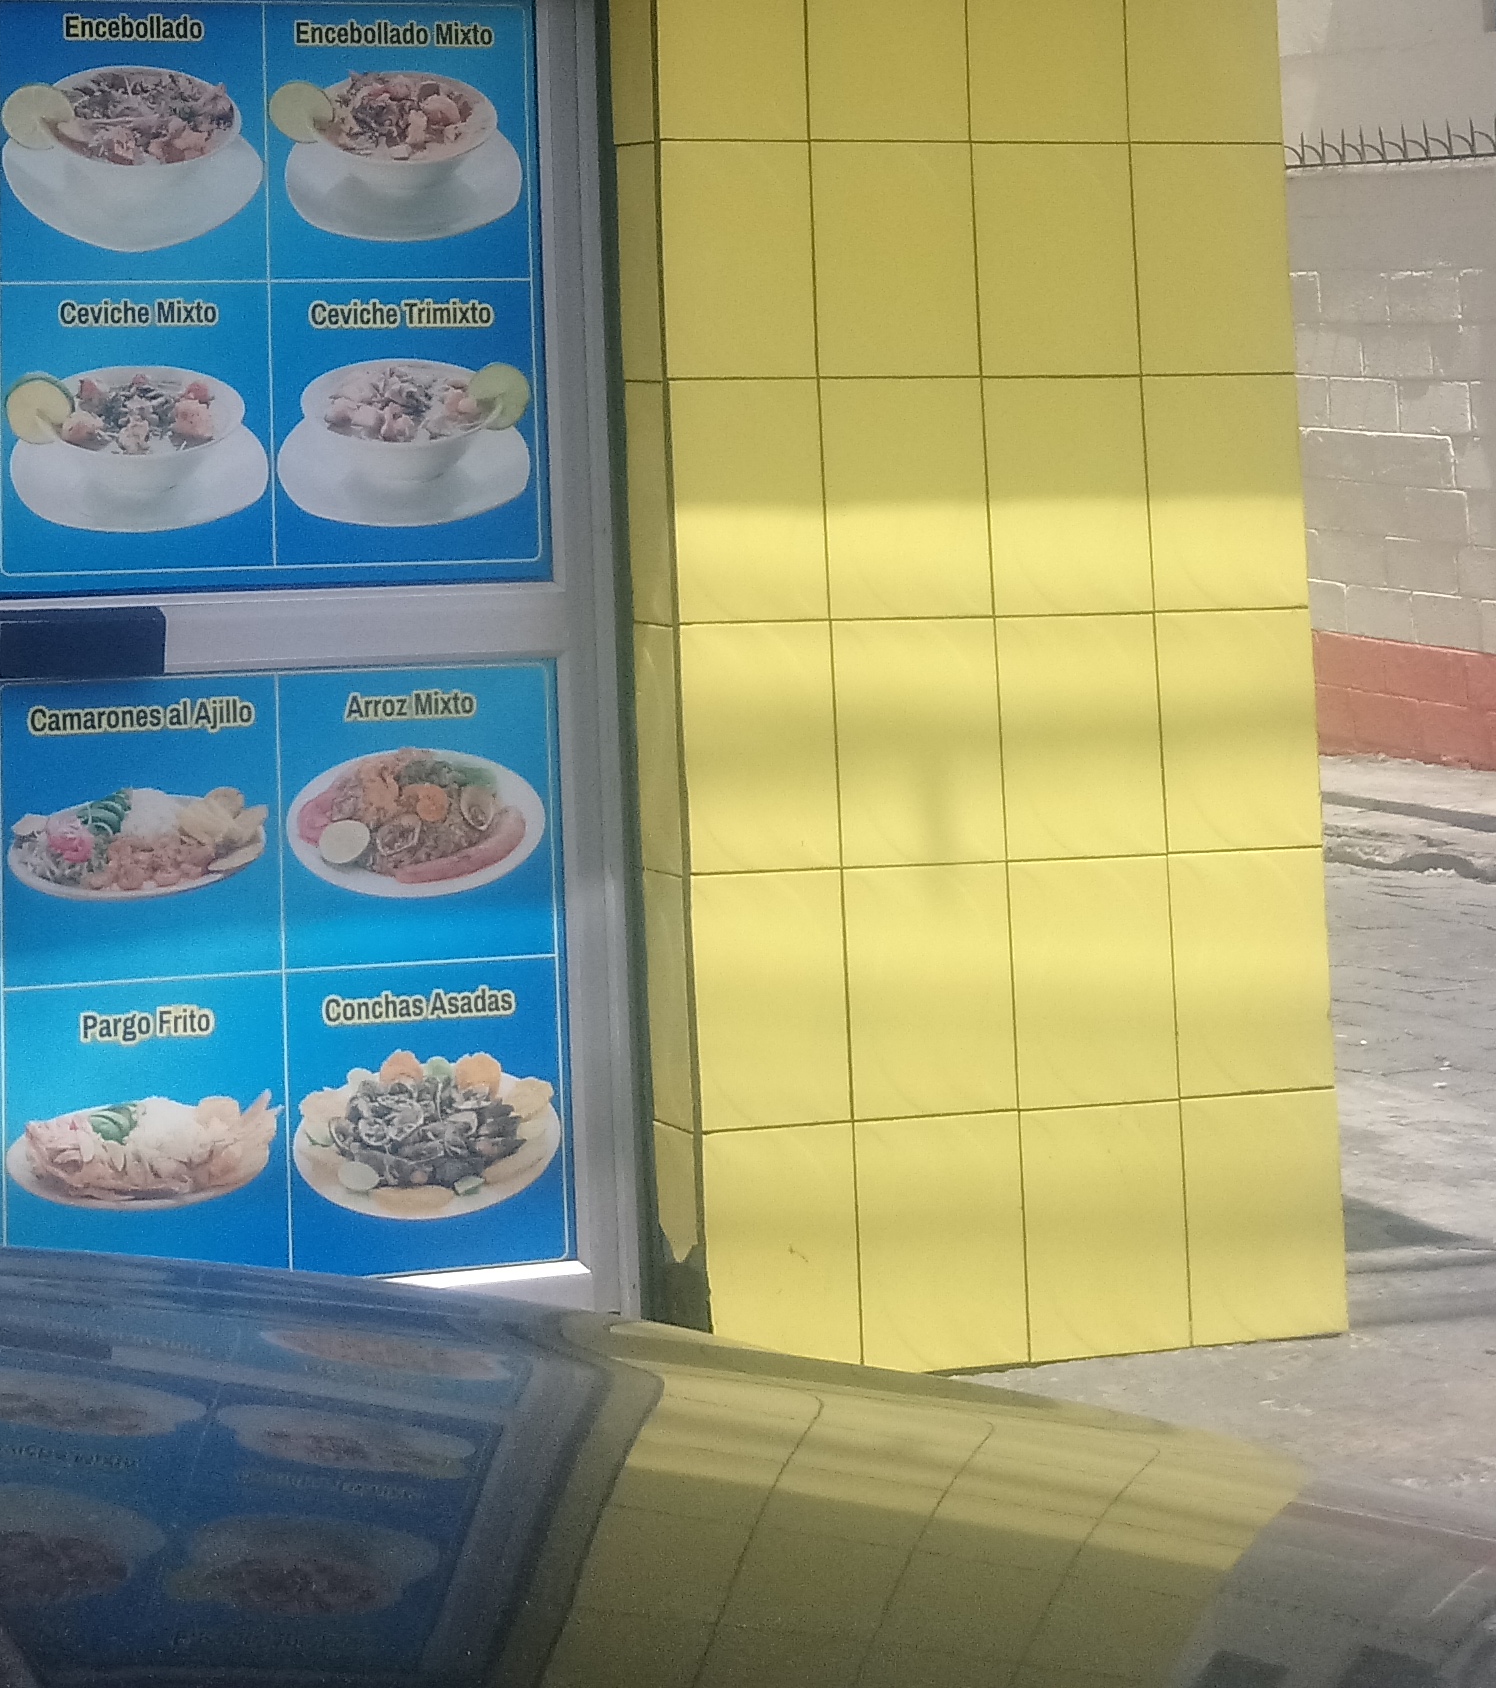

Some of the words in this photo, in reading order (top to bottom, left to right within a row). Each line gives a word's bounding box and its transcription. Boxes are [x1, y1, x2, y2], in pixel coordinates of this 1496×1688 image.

[64, 15, 204, 40] Encebollado
[295, 21, 429, 45] Encebollado
[434, 22, 494, 46] Mixto
[60, 300, 150, 325] Ceviche
[155, 300, 218, 325] Mixto
[311, 301, 399, 327] Ceviche
[403, 301, 492, 326] Trimixto
[30, 706, 162, 733] Camarones
[168, 700, 189, 726] al
[193, 697, 253, 730] Ajillo
[345, 693, 407, 720] Arroz
[414, 691, 475, 717] Mixto
[325, 992, 425, 1024] Conchas
[429, 987, 515, 1016] Asadas
[82, 1013, 152, 1042] Pargo
[157, 1006, 211, 1036] Frito
